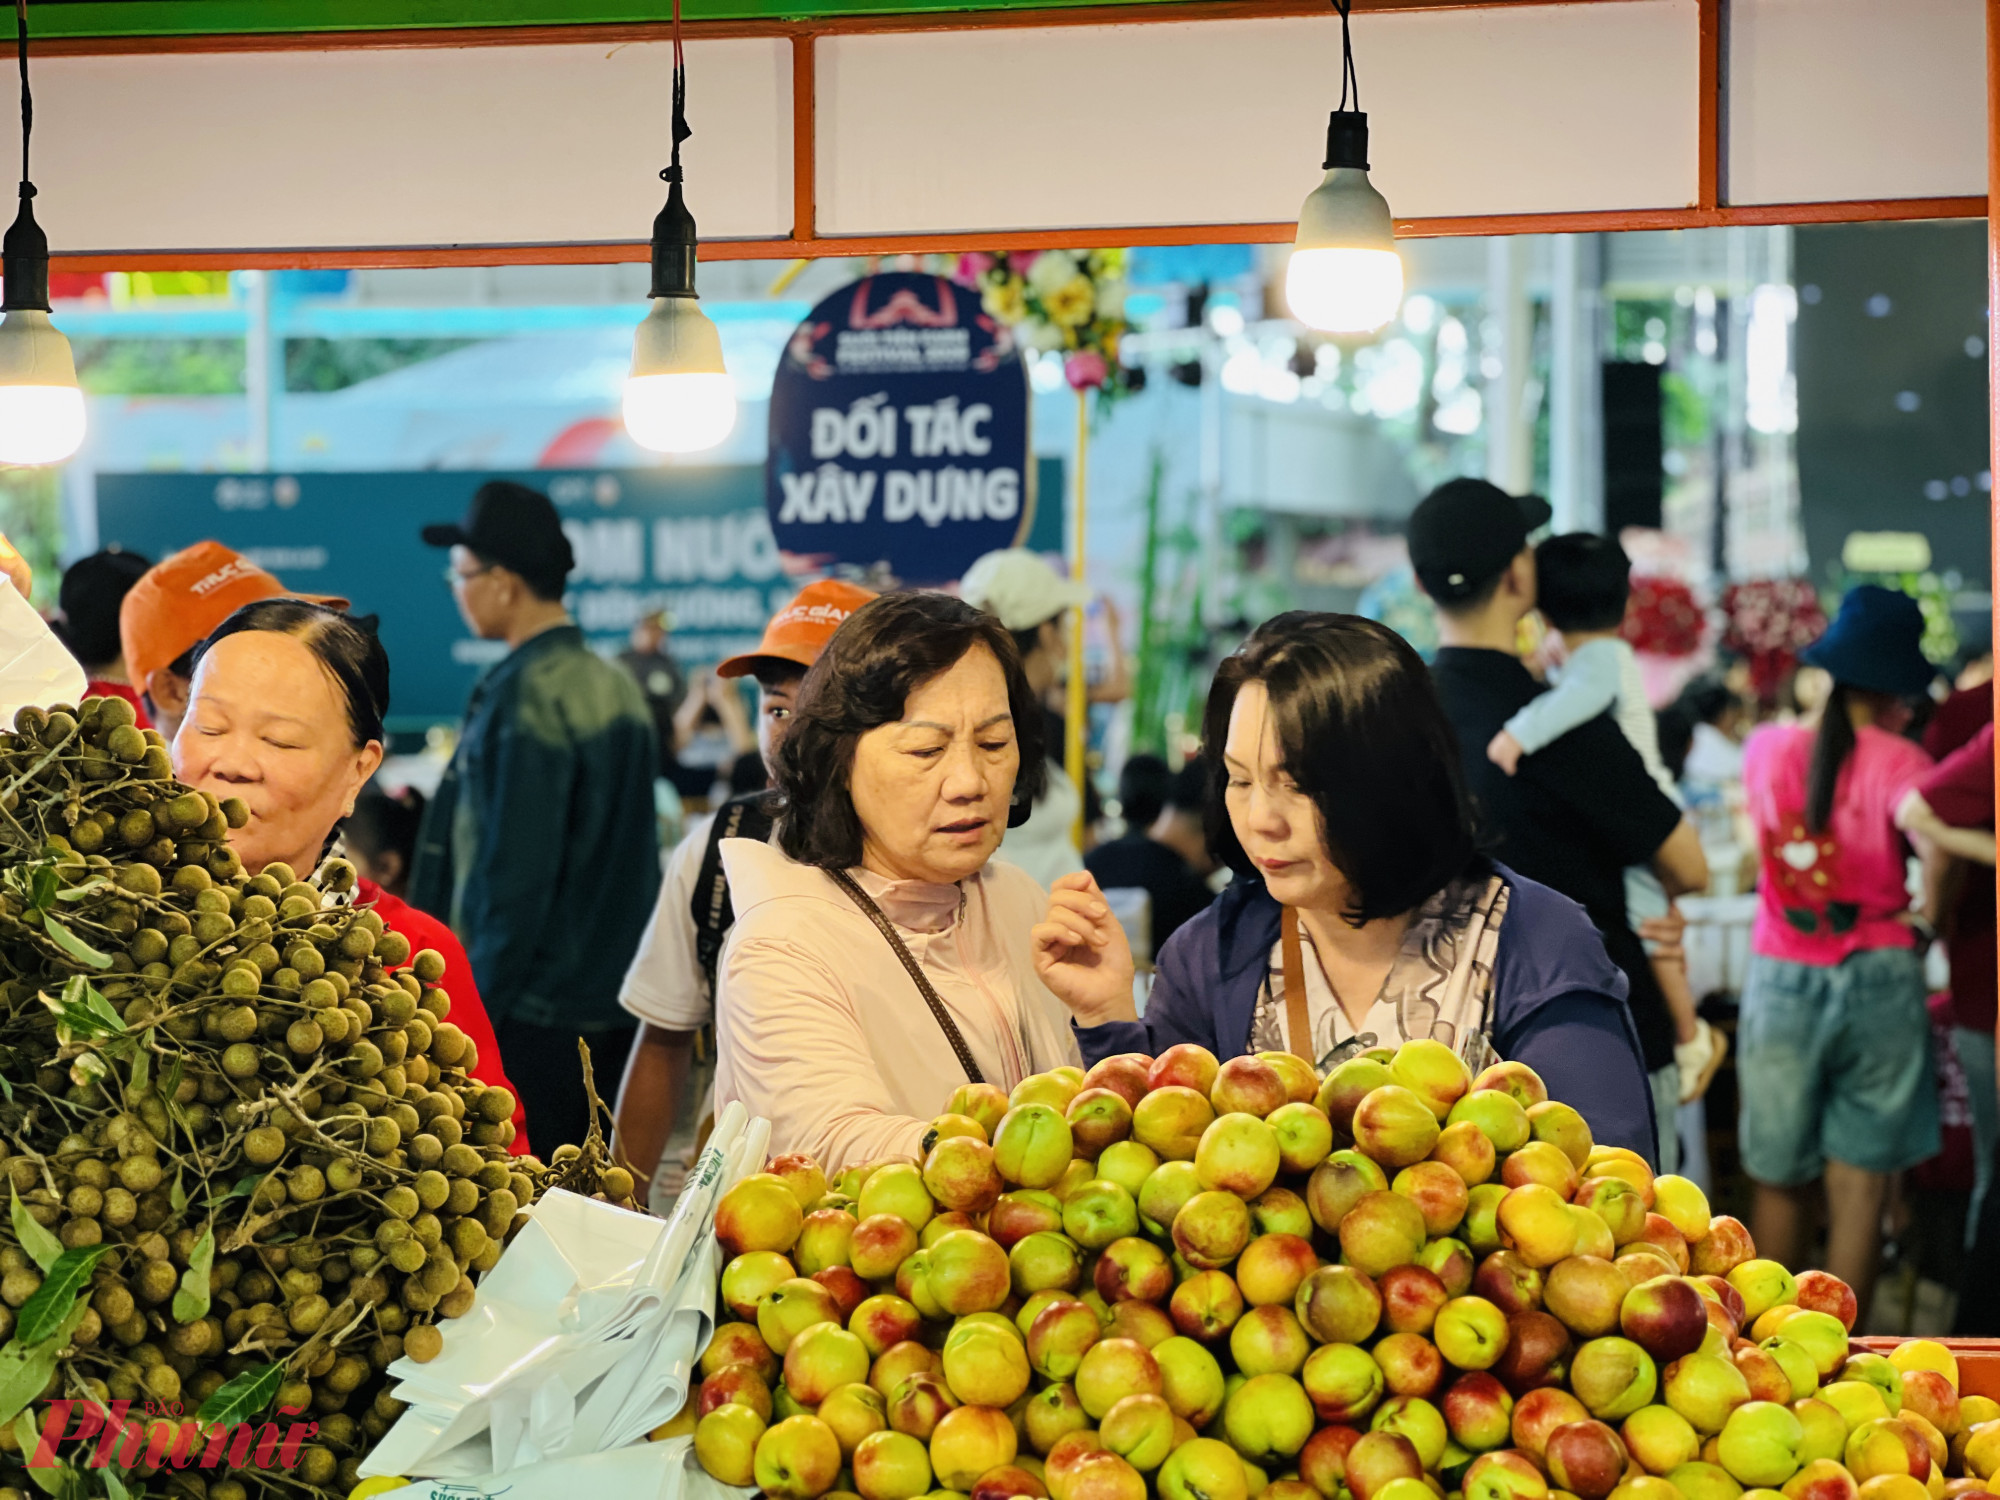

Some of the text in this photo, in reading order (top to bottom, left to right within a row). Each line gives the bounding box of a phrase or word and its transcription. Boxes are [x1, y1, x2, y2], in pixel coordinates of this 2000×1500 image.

[811, 391, 993, 459] ĐỐI TÁC
[779, 462, 1019, 527] XÂY DỰNG
